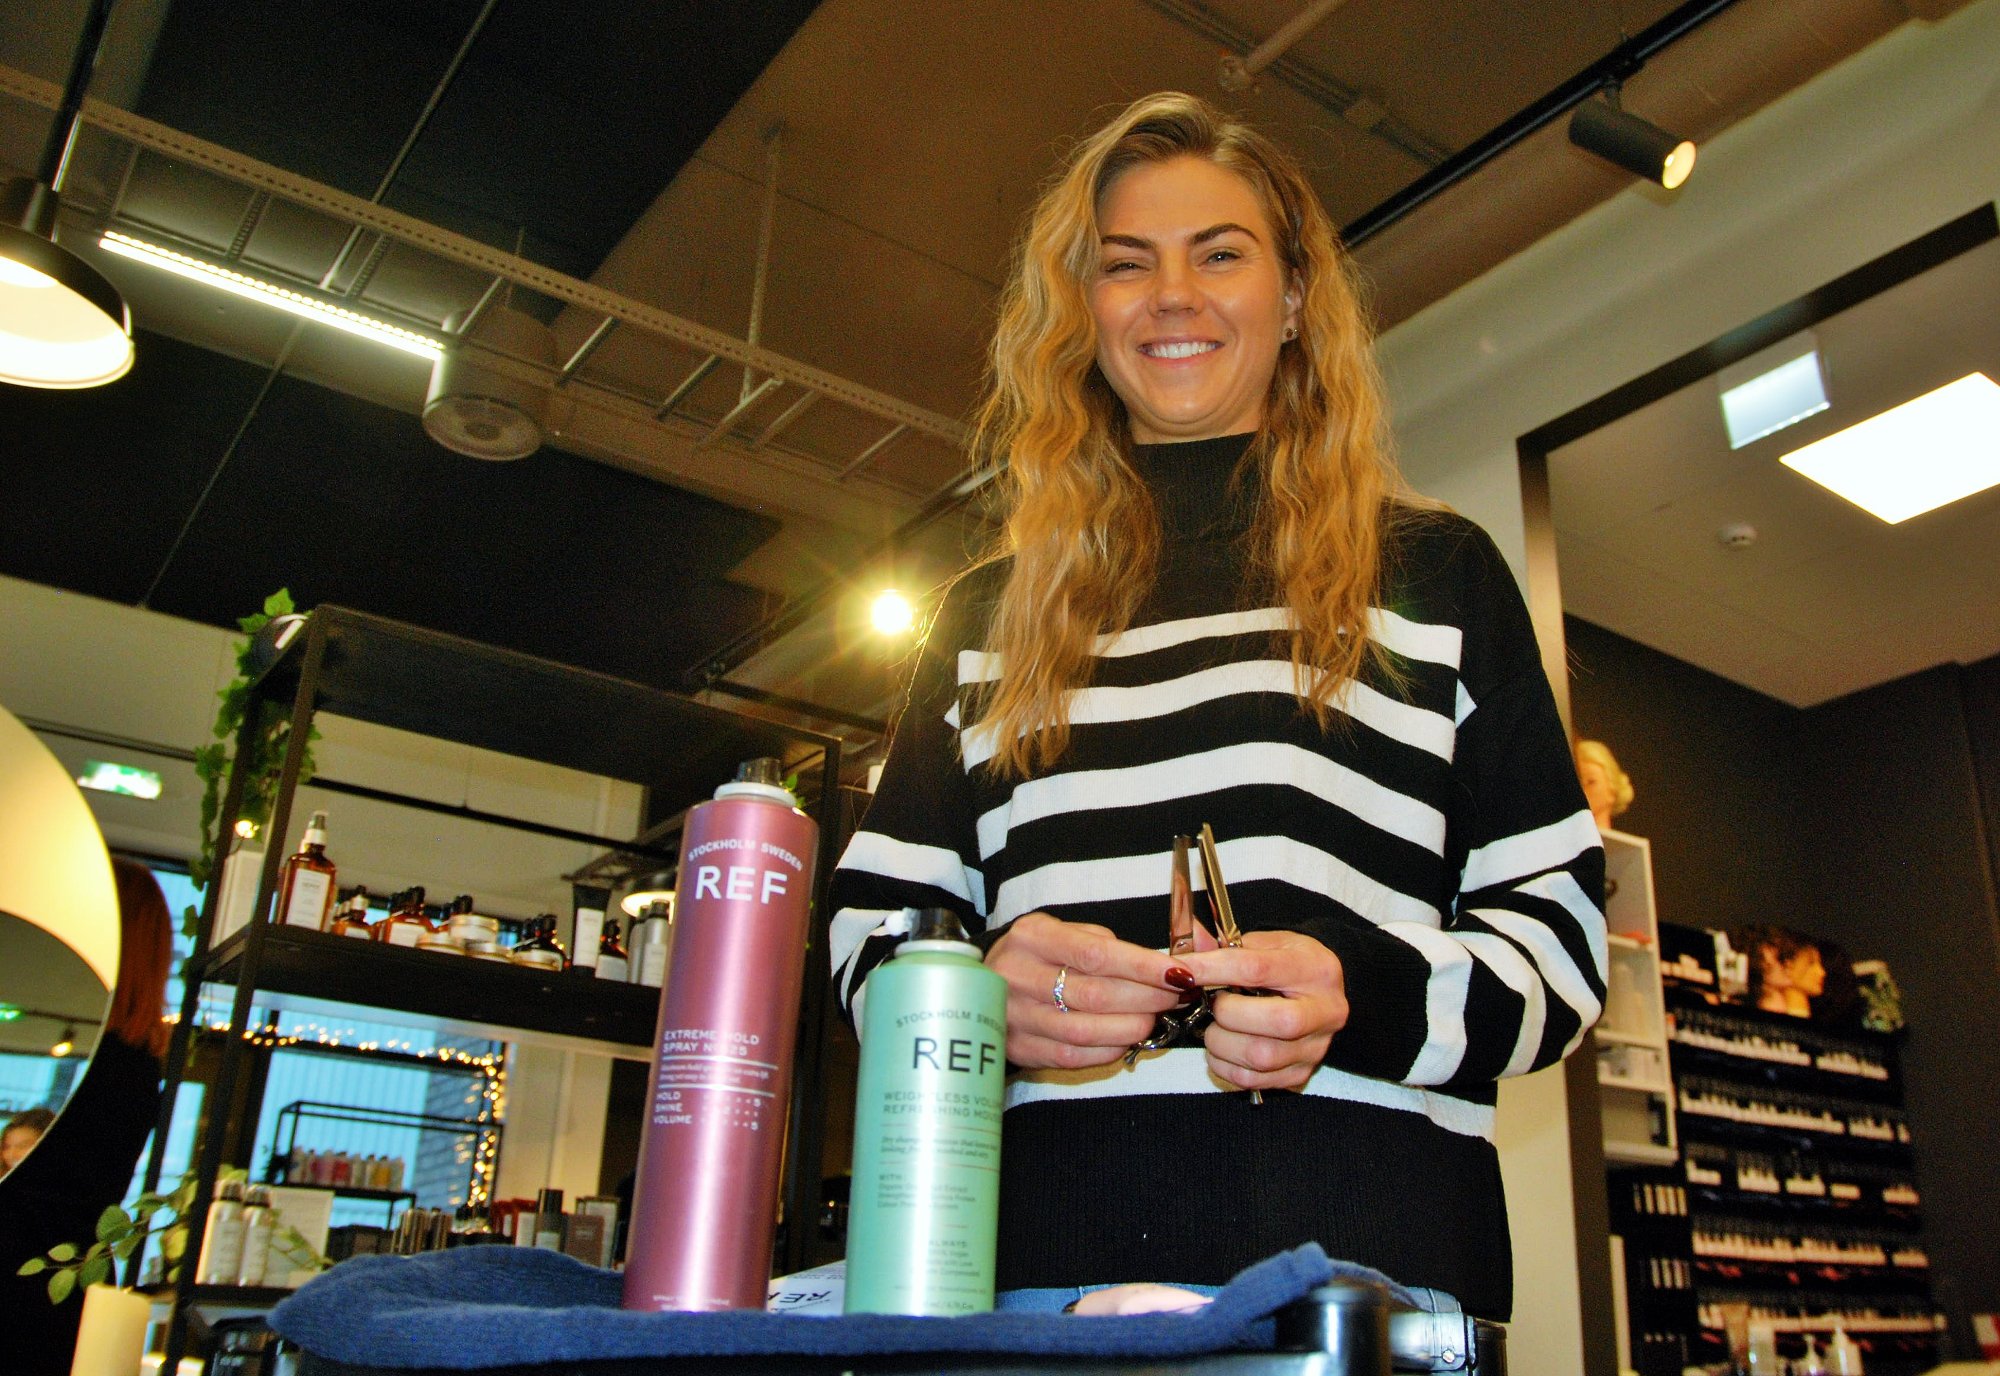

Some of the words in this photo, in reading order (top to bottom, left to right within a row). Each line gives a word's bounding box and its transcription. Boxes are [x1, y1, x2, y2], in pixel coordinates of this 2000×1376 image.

[688, 838, 756, 861] STOCKHOLM
[761, 842, 803, 872] SWEDEN
[695, 865, 788, 905] REF
[896, 1009, 971, 1028] STOCKHOLM
[664, 1029, 718, 1041] EXTREME
[662, 1042, 699, 1053] SPRAY
[912, 1036, 996, 1075] REF
[656, 1091, 681, 1101] HOLD
[884, 1090, 970, 1104] WEIGHLESS
[655, 1103, 683, 1112] SHINE
[654, 1115, 692, 1124] VOLUME
